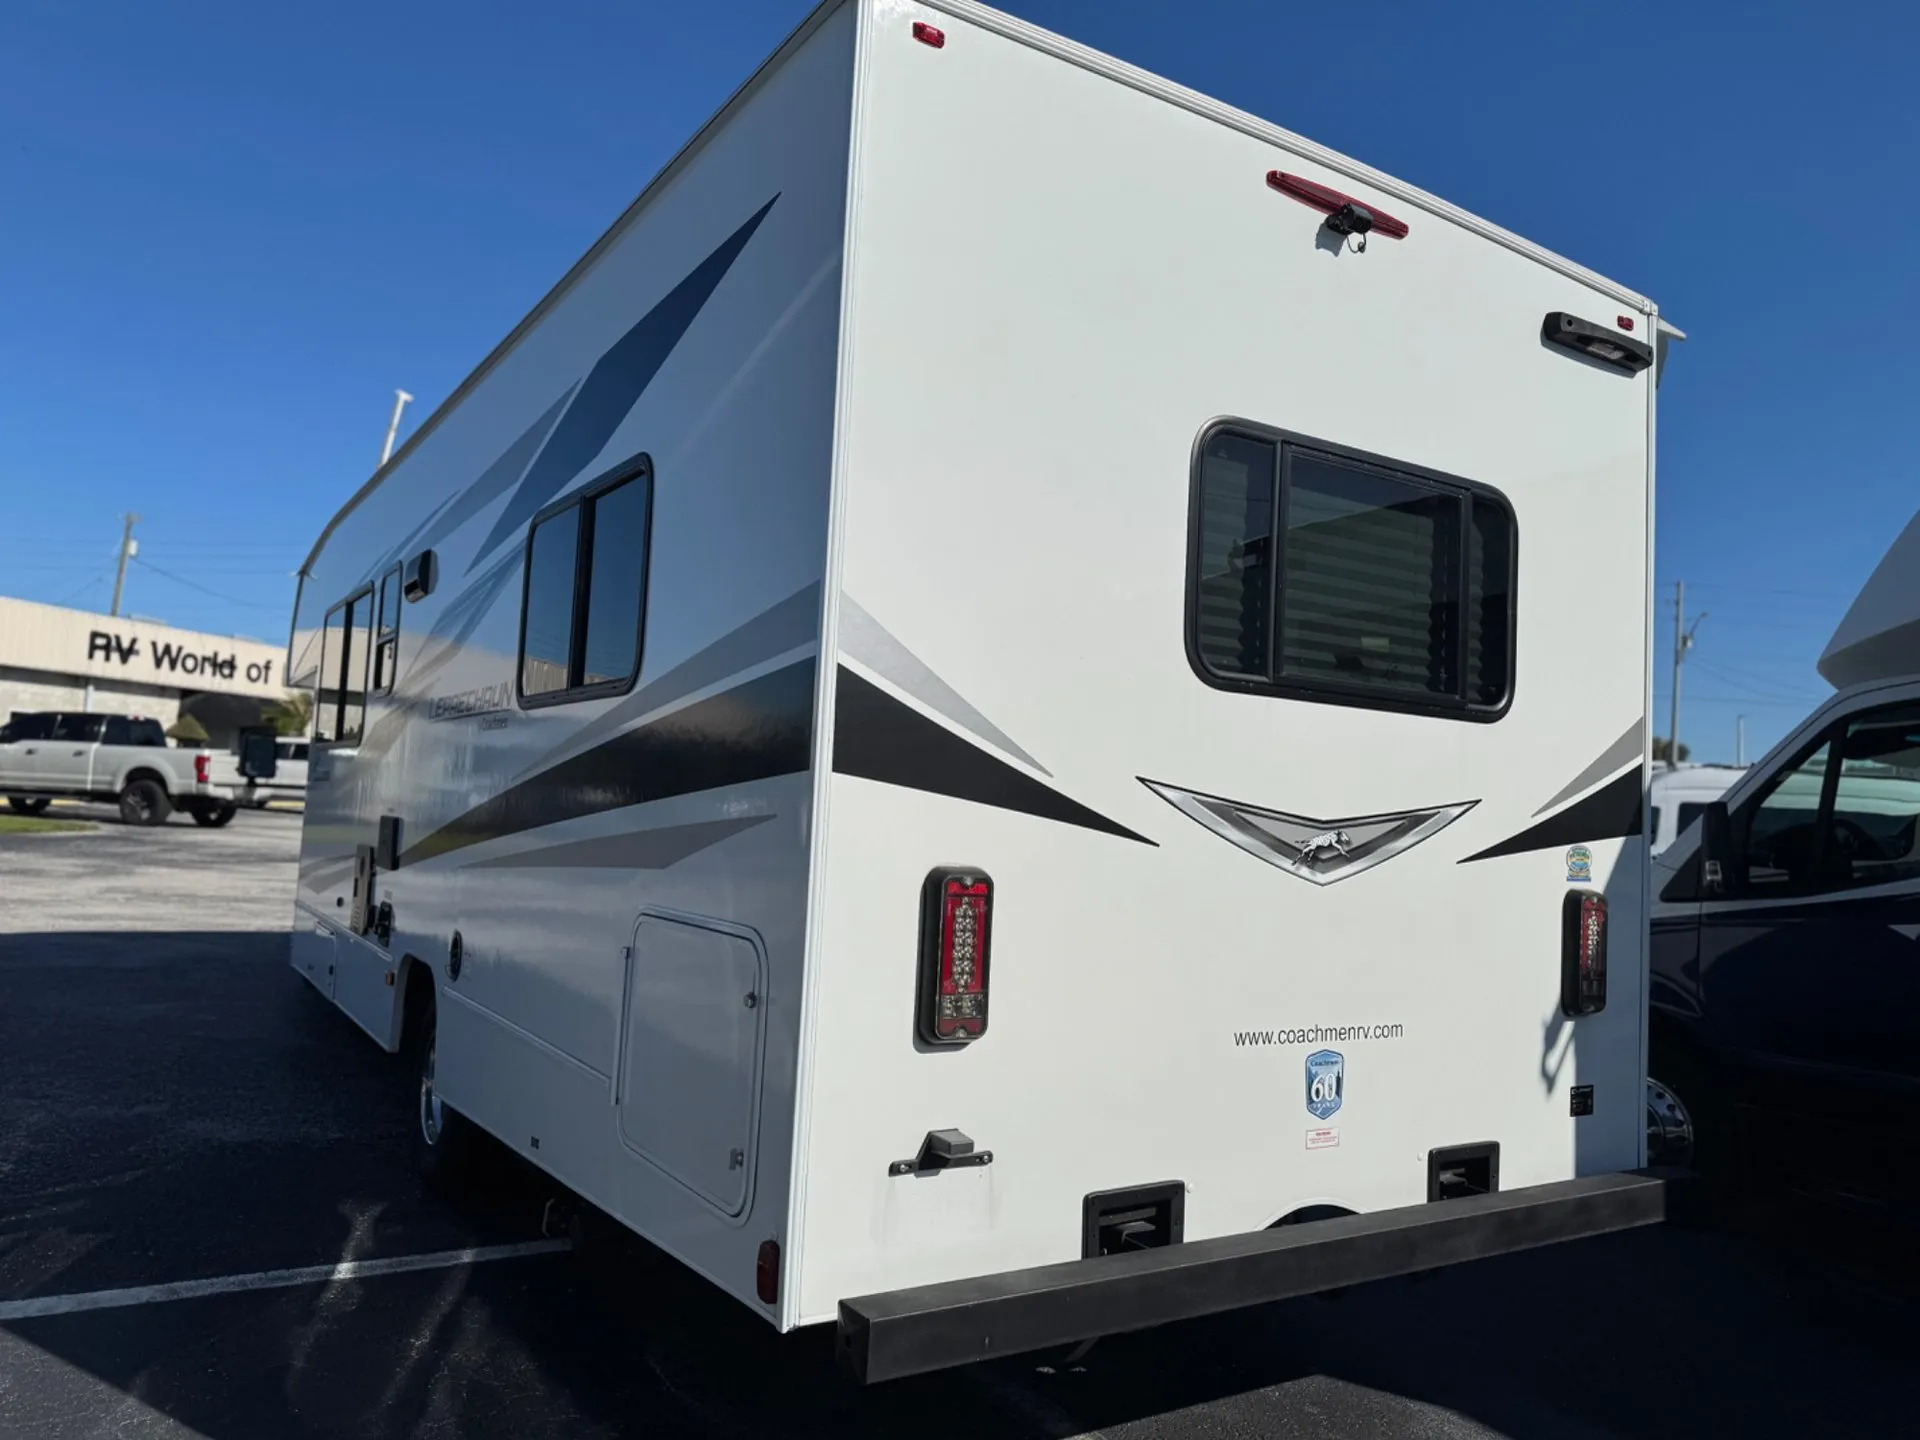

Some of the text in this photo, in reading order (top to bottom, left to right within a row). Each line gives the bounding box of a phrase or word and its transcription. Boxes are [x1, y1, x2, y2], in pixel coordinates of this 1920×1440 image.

[88, 630, 272, 684] RV World of
[1234, 1023, 1403, 1046] www.coachmenrv.com
[1311, 1073, 1337, 1102] 60
